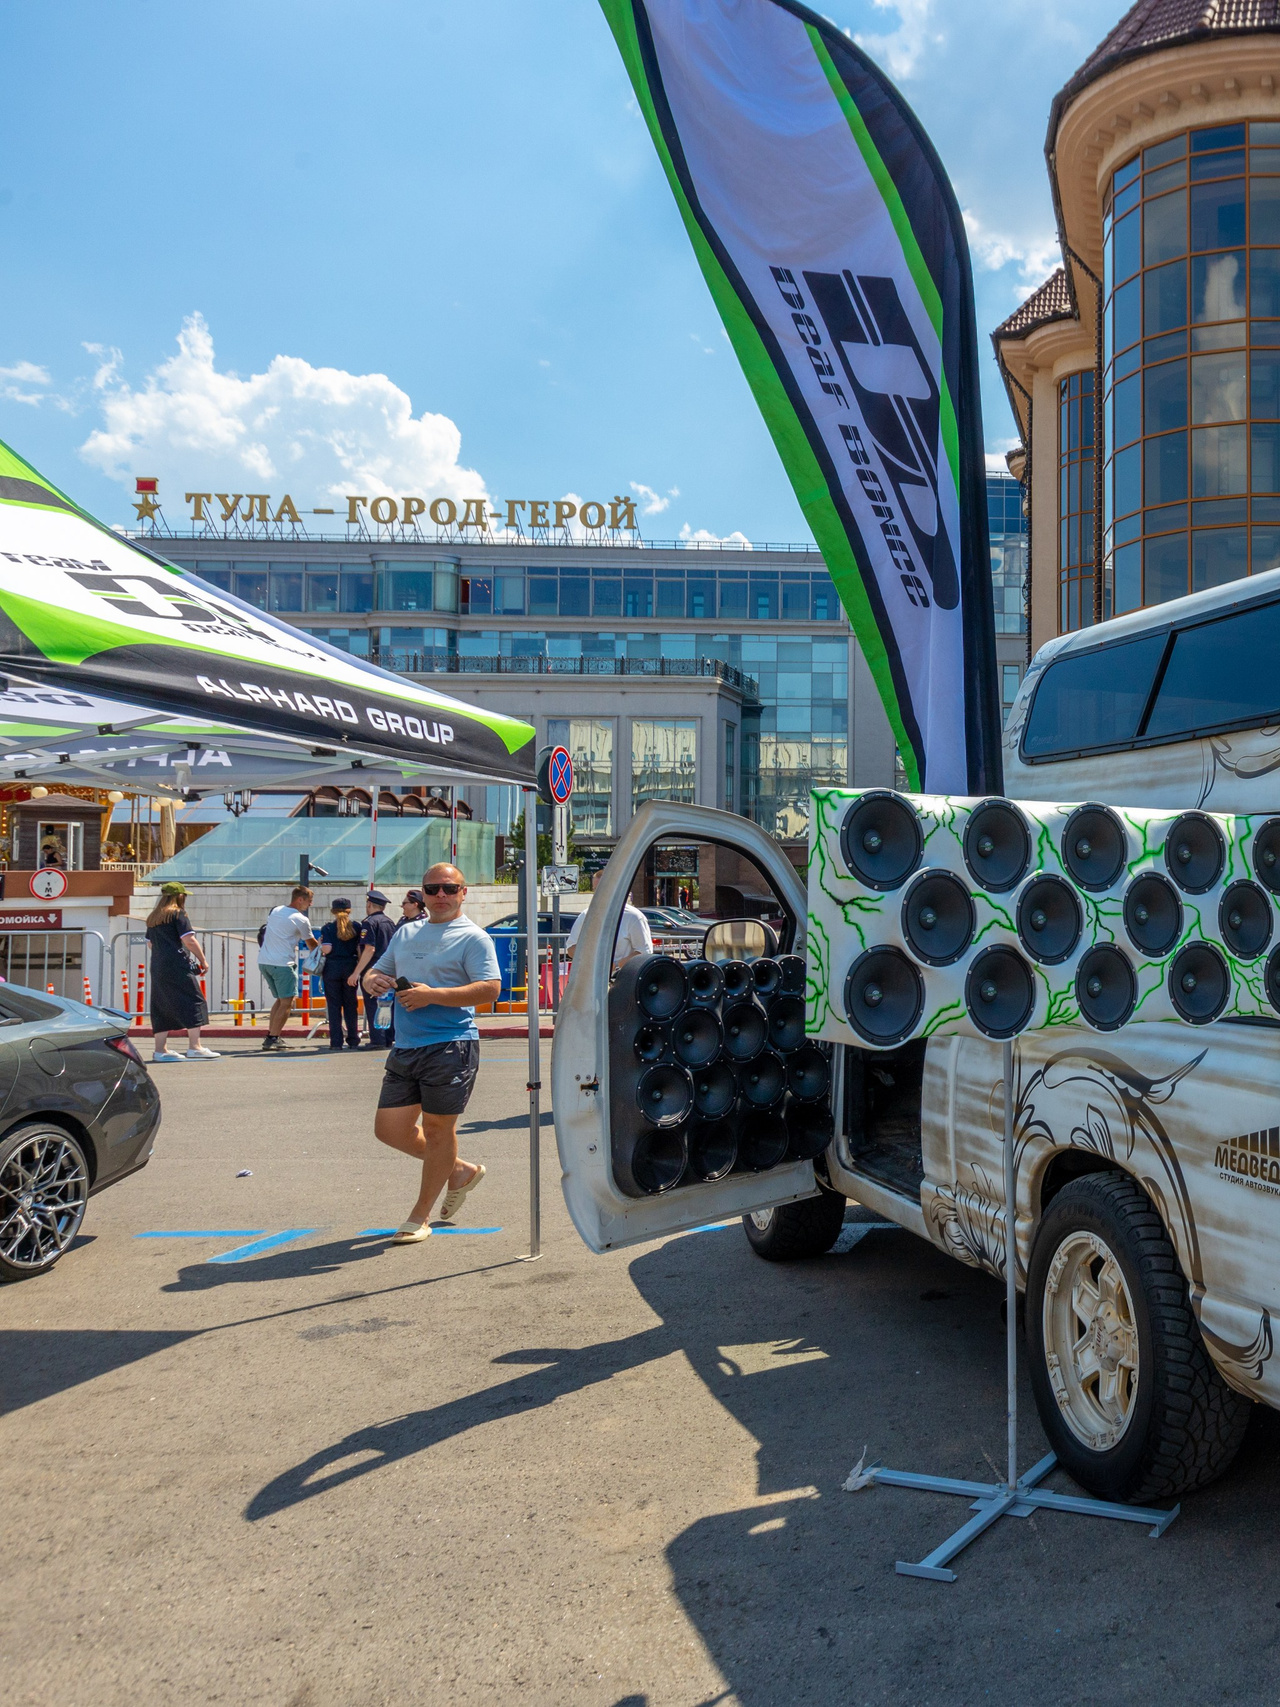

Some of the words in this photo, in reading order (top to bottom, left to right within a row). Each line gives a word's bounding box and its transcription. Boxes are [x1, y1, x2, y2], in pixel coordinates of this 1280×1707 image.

[185, 492, 301, 523] ТУЛА
[346, 495, 638, 532] ГОРОД-ГЕРОЙ
[197, 674, 359, 725] ALPHARD
[368, 707, 455, 745] GROUP
[1219, 1172, 1245, 1185] СТУДИЯ
